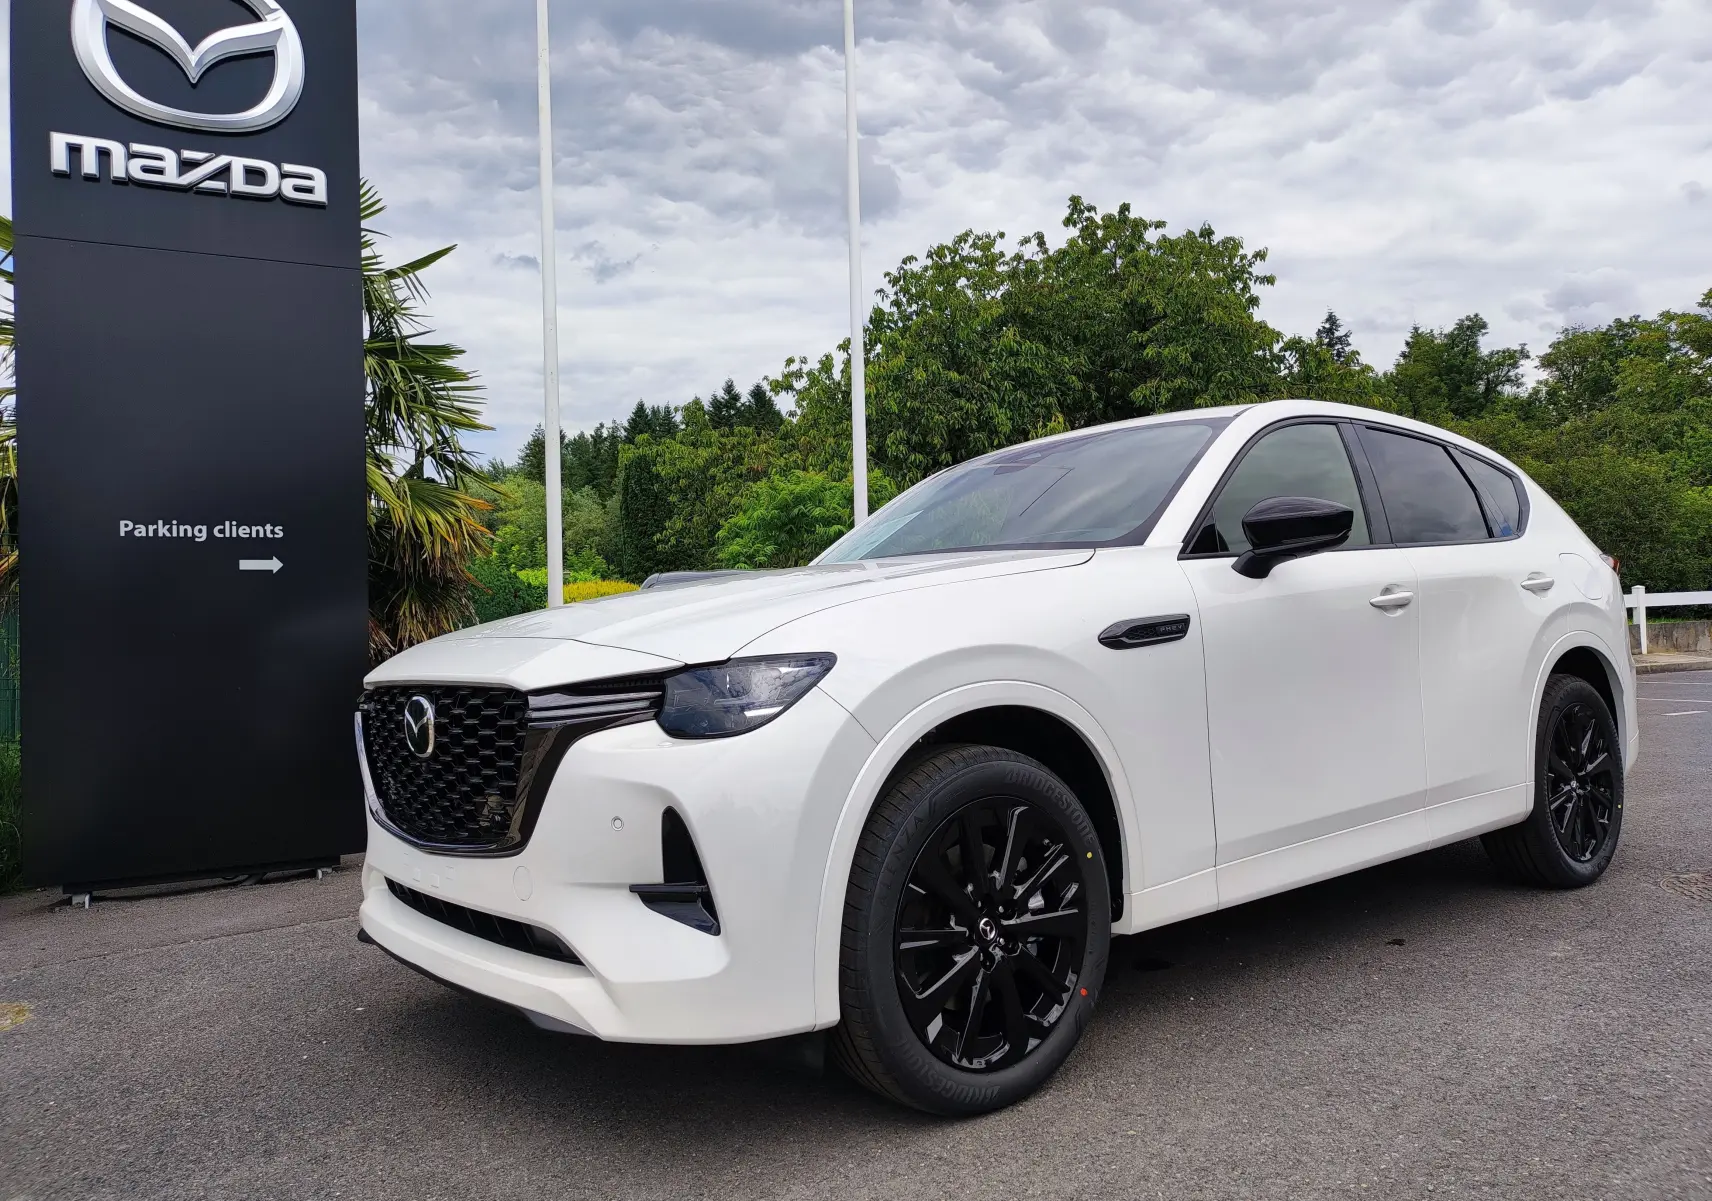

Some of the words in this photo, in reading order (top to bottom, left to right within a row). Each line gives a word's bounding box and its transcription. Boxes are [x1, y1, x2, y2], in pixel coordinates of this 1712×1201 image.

[119, 520, 208, 542] Parking
[213, 521, 284, 538] clients
[1005, 767, 1095, 847] BRIDGESTONE
